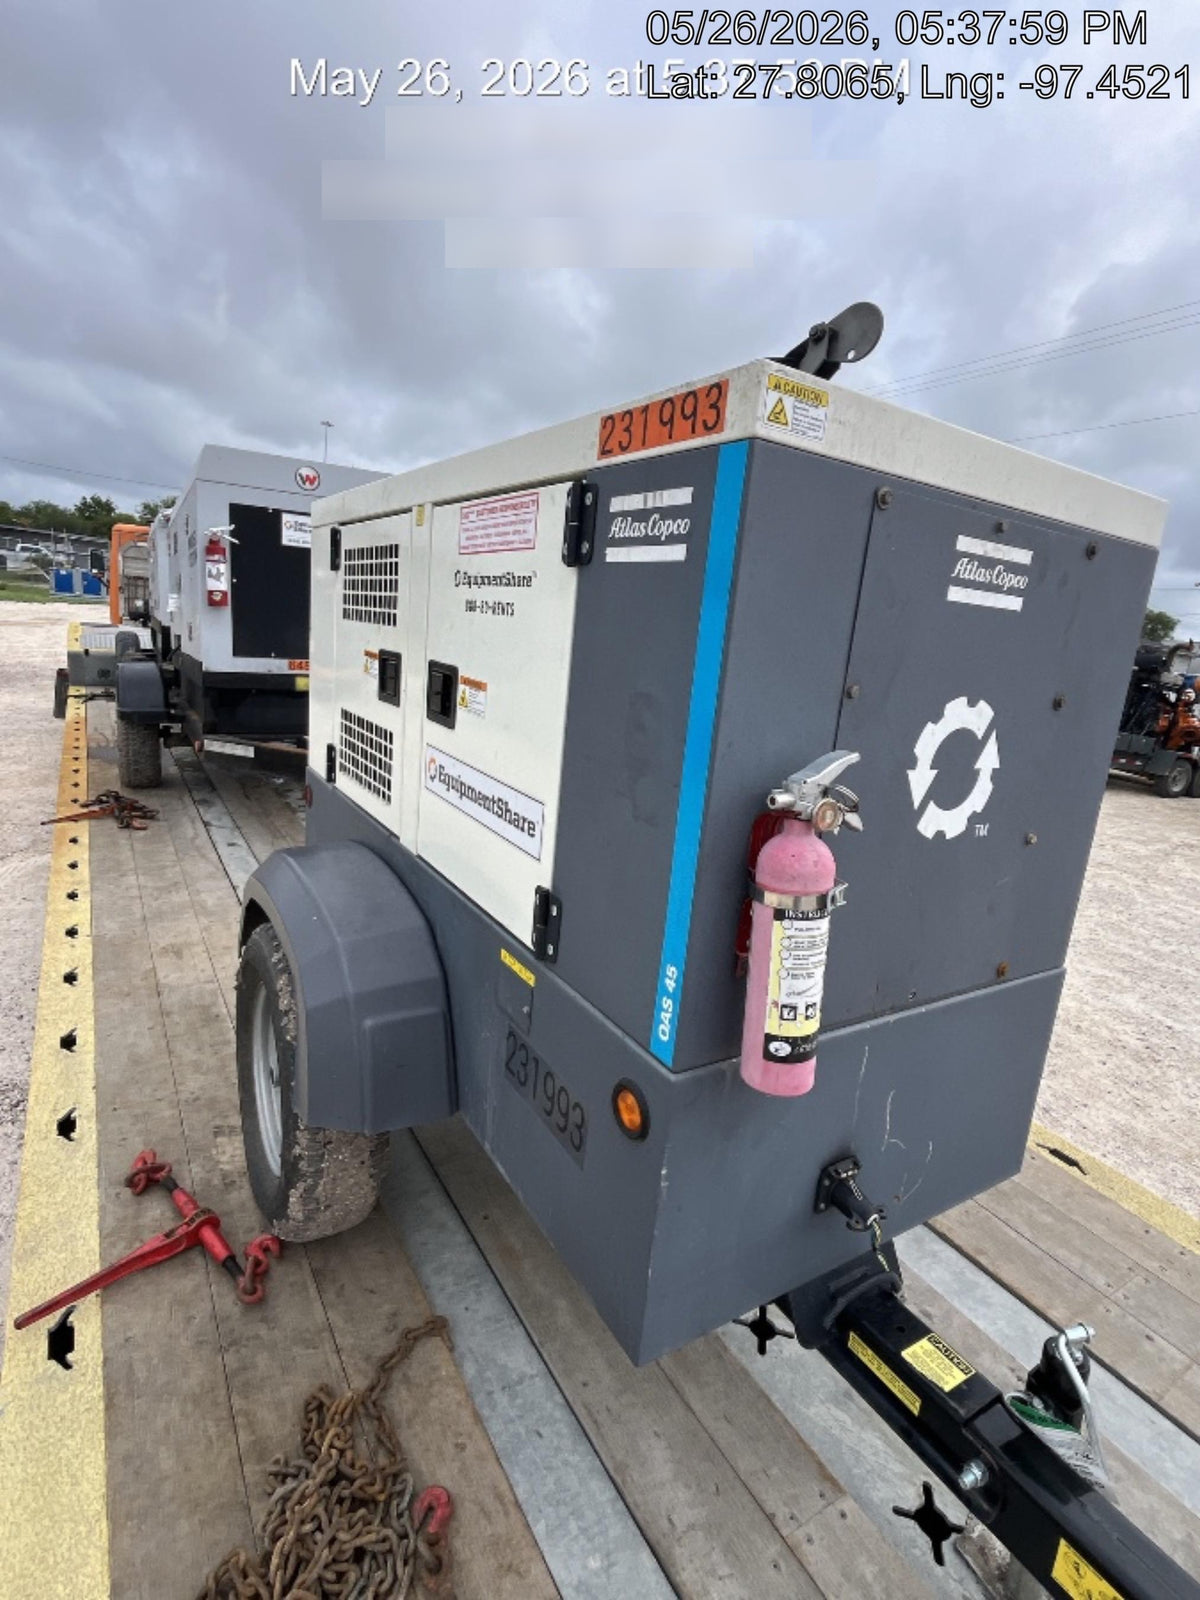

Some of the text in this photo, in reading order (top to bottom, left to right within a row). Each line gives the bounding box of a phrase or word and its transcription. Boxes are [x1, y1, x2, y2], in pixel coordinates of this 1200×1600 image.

[600, 382, 723, 456] 231993
[607, 513, 691, 541] Atlas Copco
[950, 558, 1029, 591] Atlas Copco
[438, 764, 537, 838] EquipmentShare
[663, 963, 678, 993] 45
[504, 1030, 586, 1153] 231993
